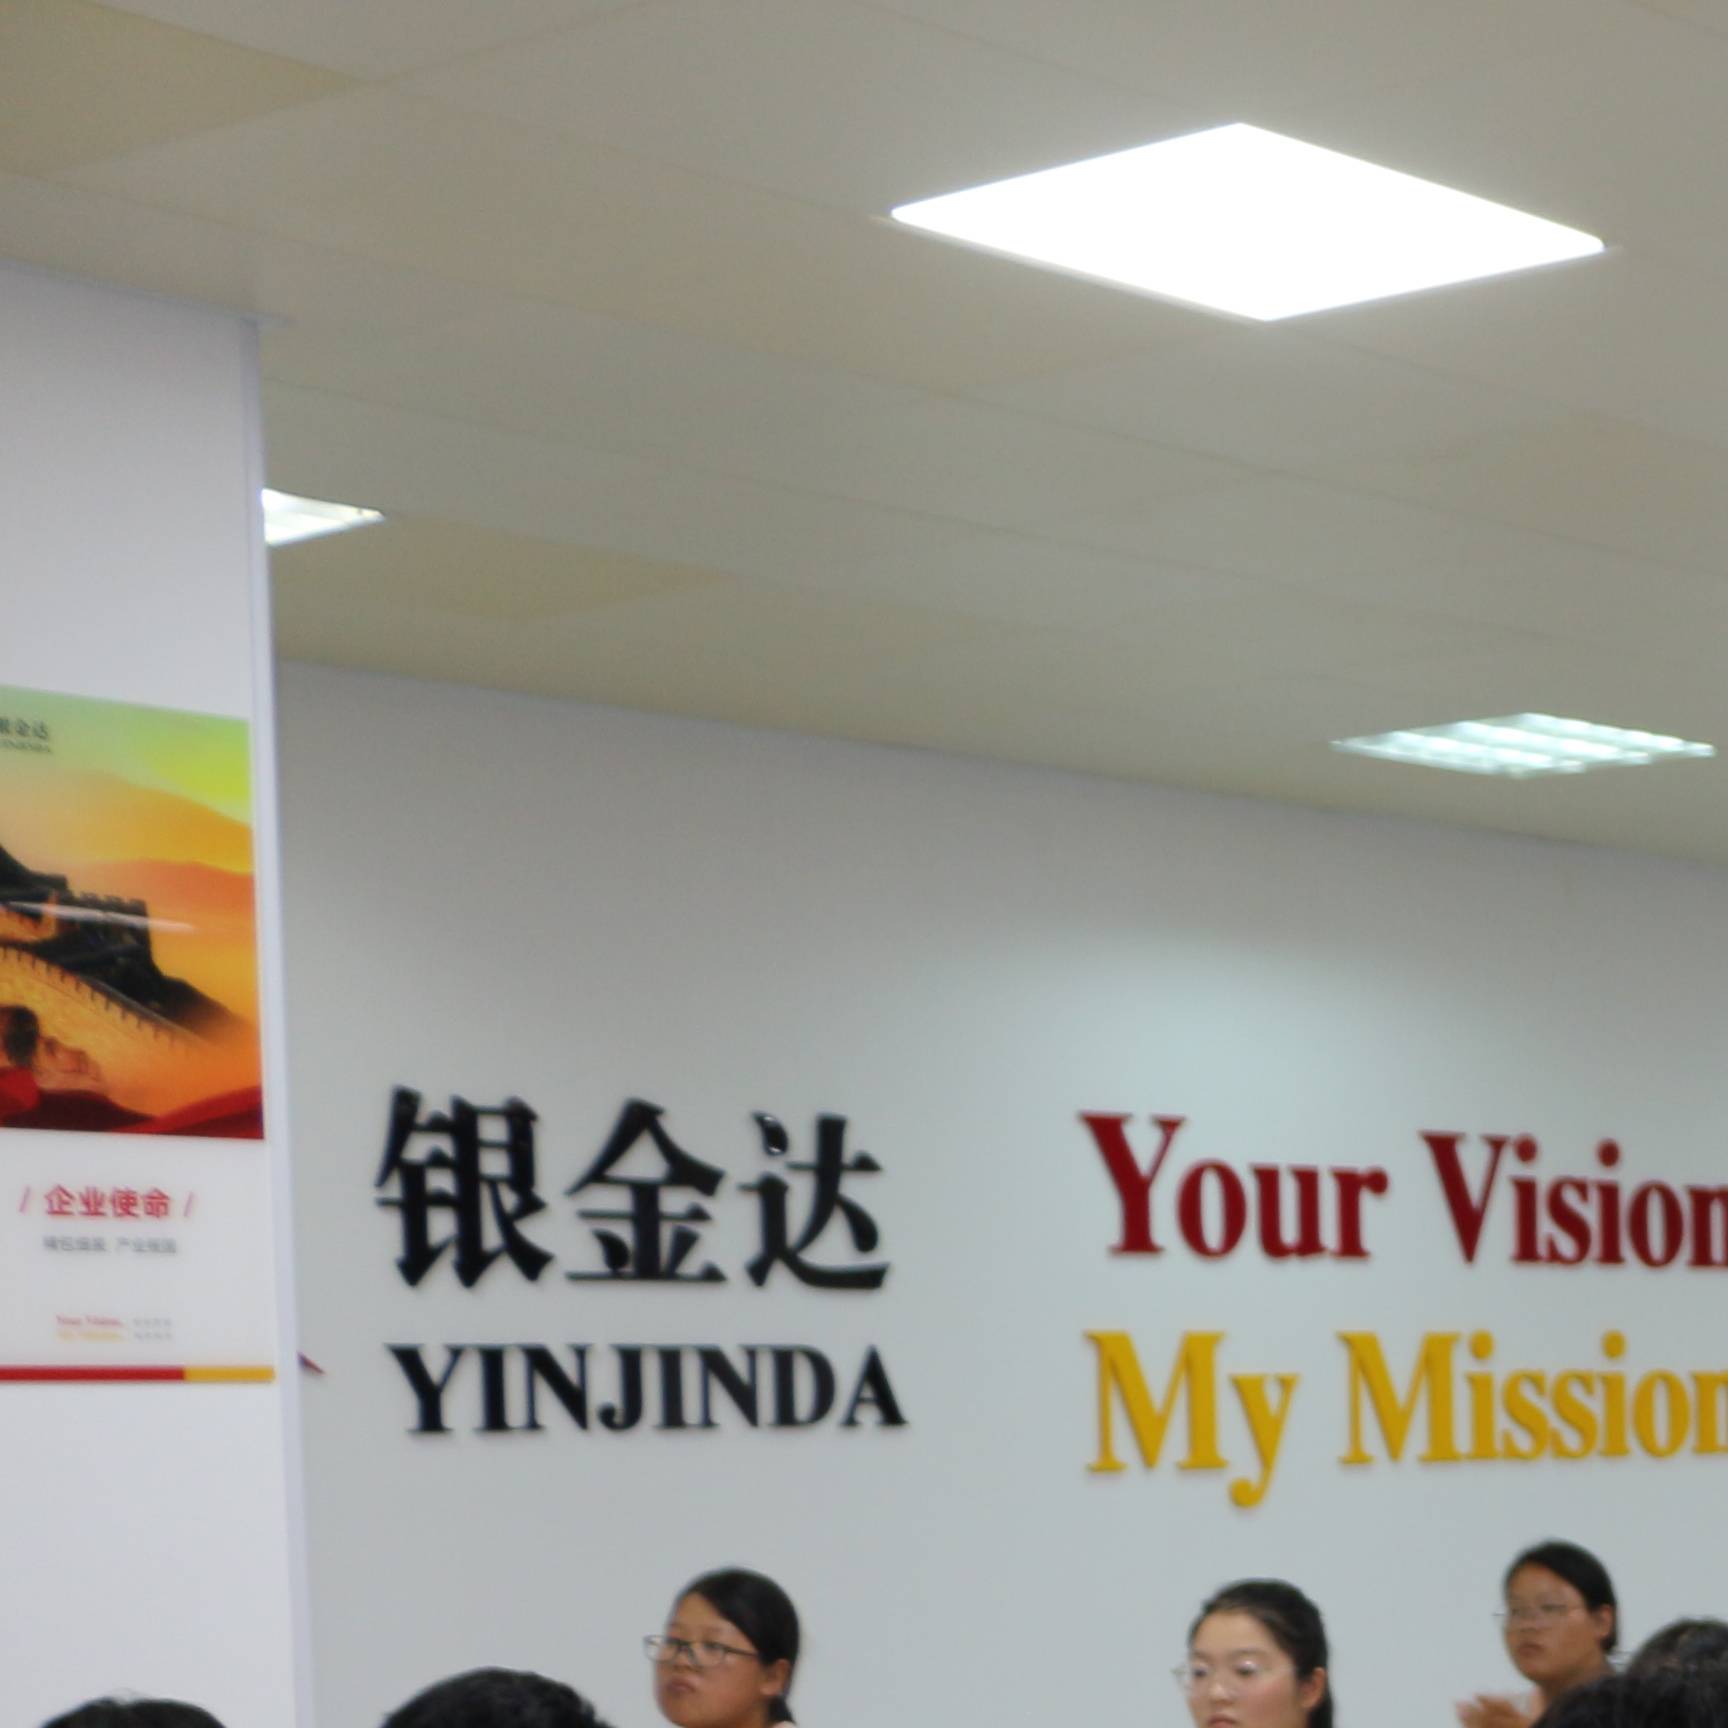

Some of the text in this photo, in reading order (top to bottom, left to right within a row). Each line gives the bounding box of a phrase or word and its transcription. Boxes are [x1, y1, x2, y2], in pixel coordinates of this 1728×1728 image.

[44, 1184, 171, 1218] 企业使命
[375, 1085, 889, 1289] 银金达
[1077, 1111, 1389, 1260] Your
[384, 1343, 908, 1433] YINJINDA
[1083, 1330, 1300, 1509] My
